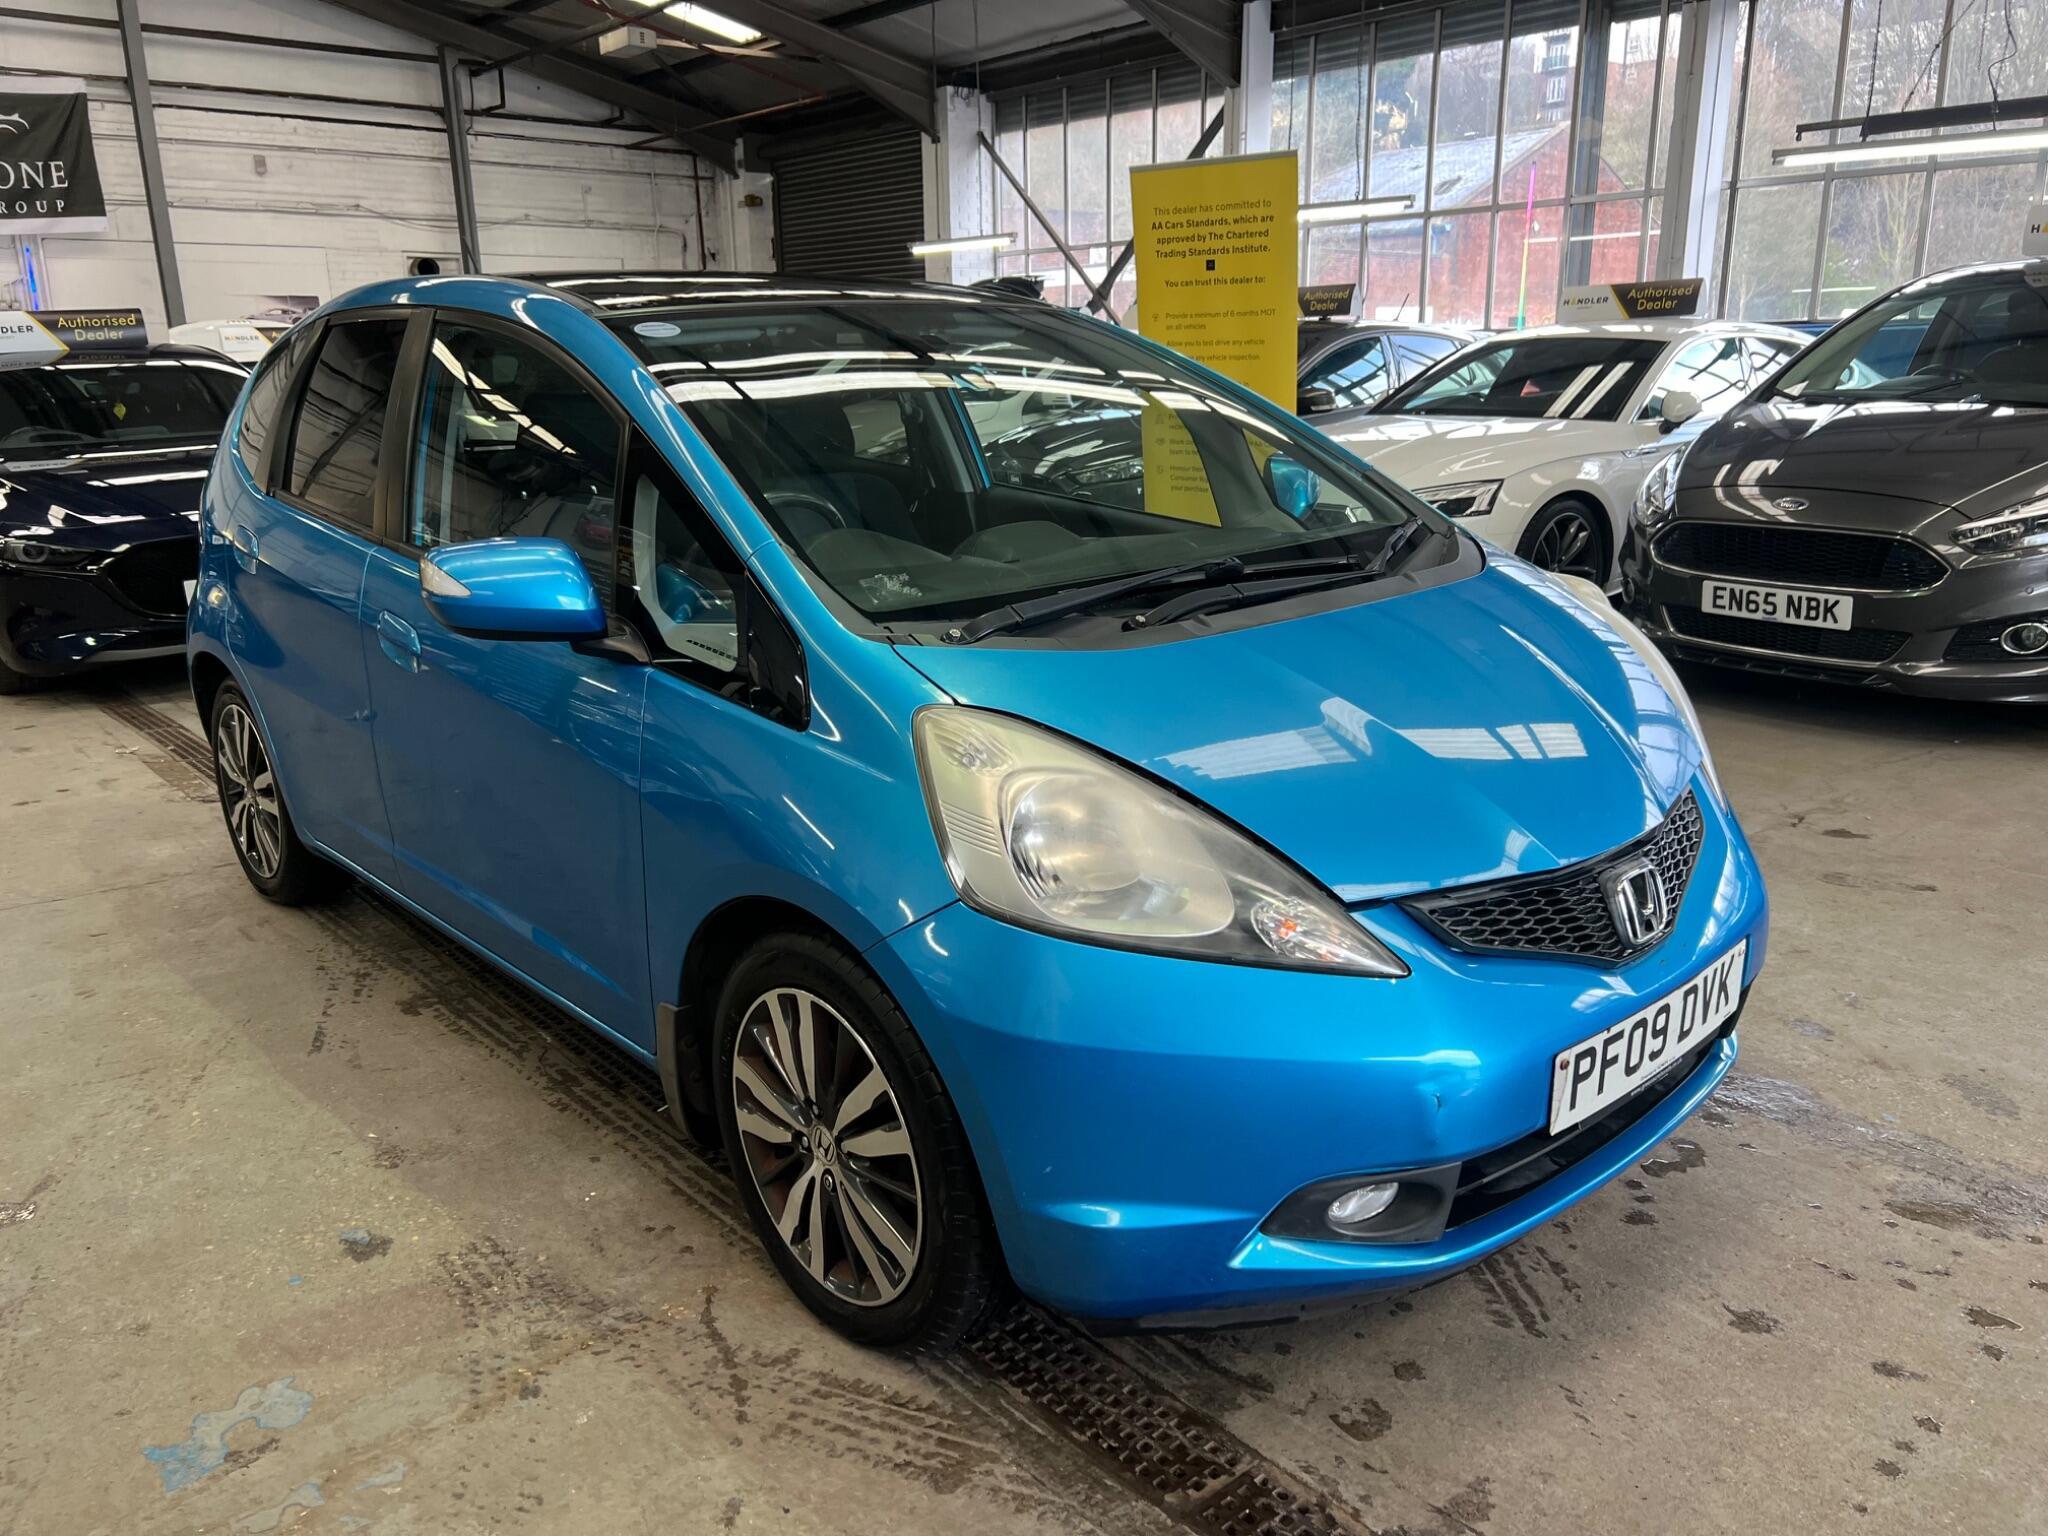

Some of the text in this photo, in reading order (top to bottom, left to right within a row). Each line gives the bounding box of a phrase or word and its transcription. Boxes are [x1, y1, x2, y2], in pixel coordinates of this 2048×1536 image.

[1153, 200, 1271, 216] This dealer has committed to
[1152, 214, 1274, 230] AA Cars Standards, which are
[1156, 228, 1269, 245] approved by The Chartered
[1155, 244, 1271, 259] Trading Standards Institute.
[1165, 279, 1179, 288] You
[1195, 278, 1212, 286] trust
[1213, 276, 1228, 285] this
[1229, 275, 1253, 285] dealer
[1254, 275, 1266, 283] to:
[1304, 288, 1350, 300] Authorised
[1627, 284, 1694, 299] Authorised
[1310, 300, 1338, 311] Dealer
[1637, 299, 1678, 311] Dealer
[58, 313, 136, 328] Authorised
[1165, 312, 1188, 320] Provide
[1222, 310, 1230, 318] of
[1236, 309, 1260, 317] months
[1260, 308, 1276, 316] MOT
[74, 328, 124, 341] Dealer
[1244, 338, 1265, 346] vehicle
[1712, 586, 1840, 624] EN65 NBK
[1569, 953, 1735, 1111] PF09 DVK
